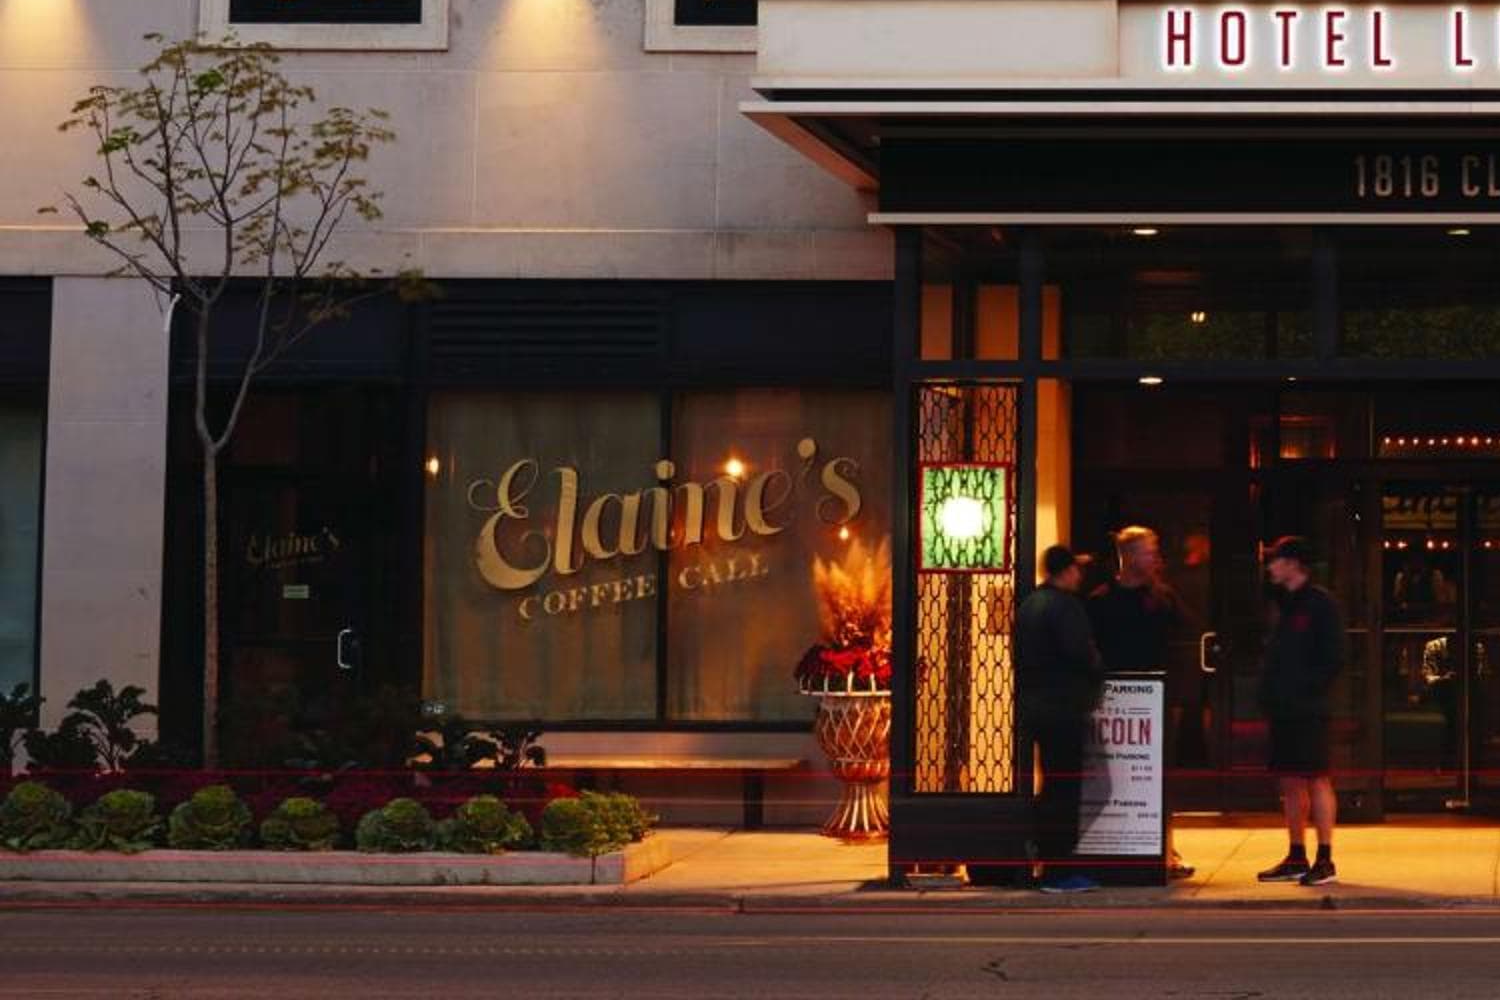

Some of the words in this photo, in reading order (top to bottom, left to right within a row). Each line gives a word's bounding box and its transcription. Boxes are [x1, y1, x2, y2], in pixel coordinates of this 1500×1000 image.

[1166, 10, 1391, 67] HOTEL
[1354, 155, 1440, 198] 1816
[467, 437, 862, 590] Elaine's
[518, 573, 656, 620] COFFEE
[679, 552, 769, 590] CALL
